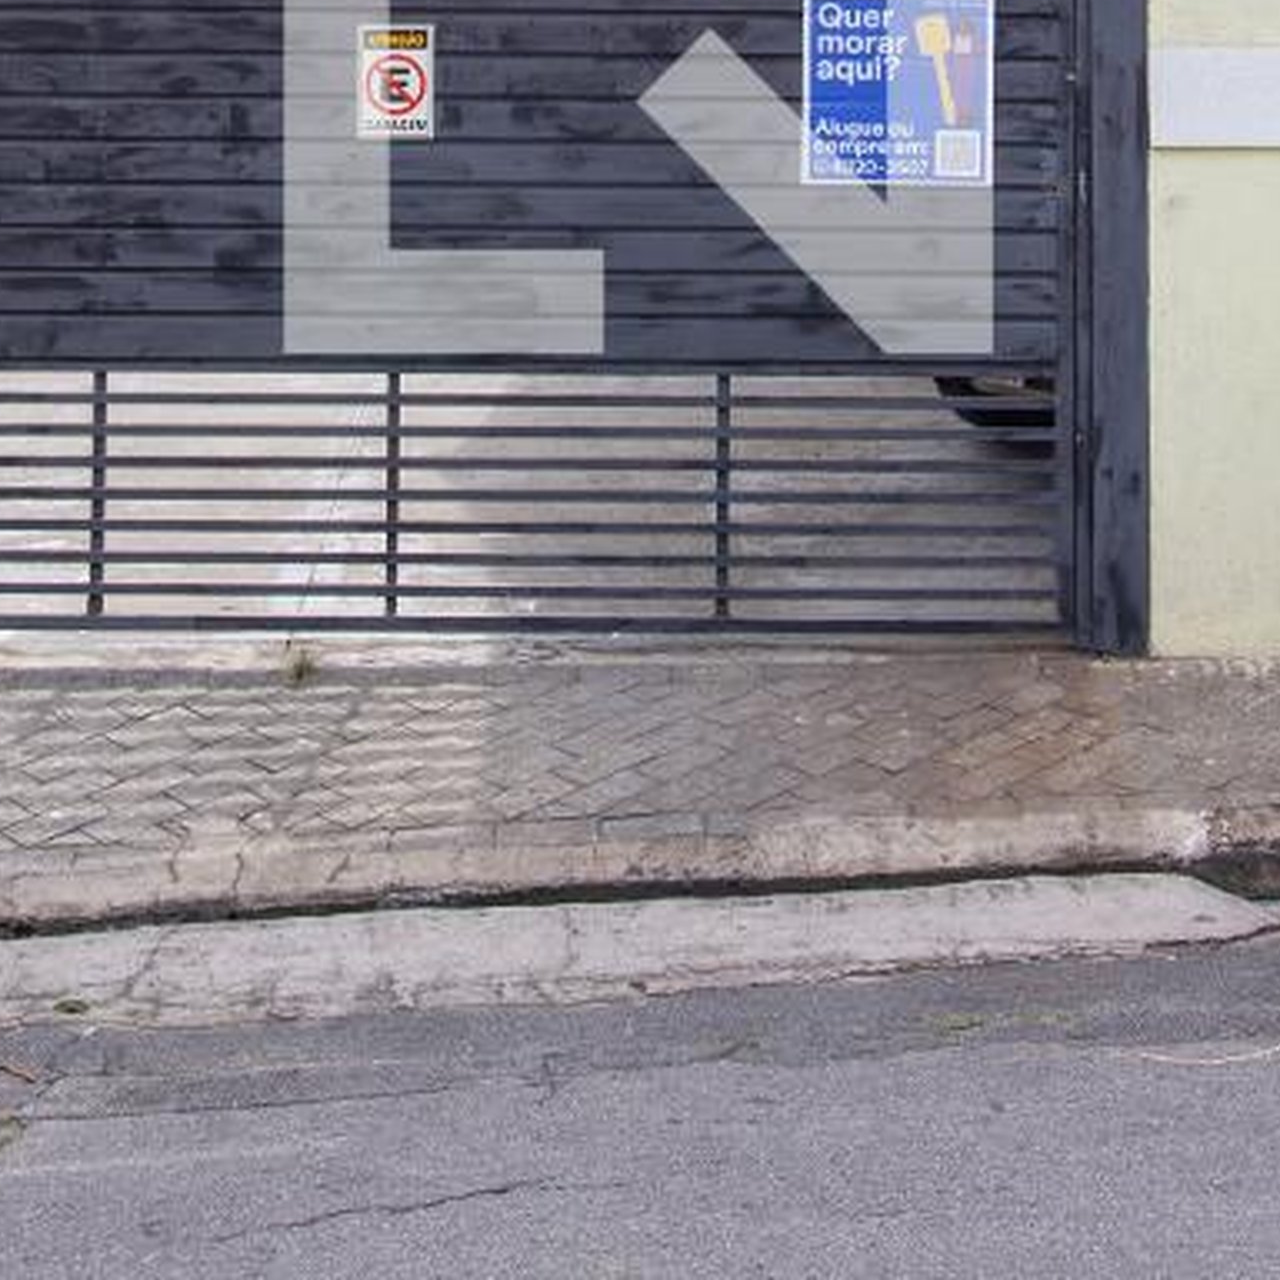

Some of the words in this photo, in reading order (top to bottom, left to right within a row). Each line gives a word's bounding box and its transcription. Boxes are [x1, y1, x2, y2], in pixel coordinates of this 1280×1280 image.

[817, 2, 895, 28] Quer
[817, 32, 908, 54] morar
[815, 55, 901, 86] aqui?
